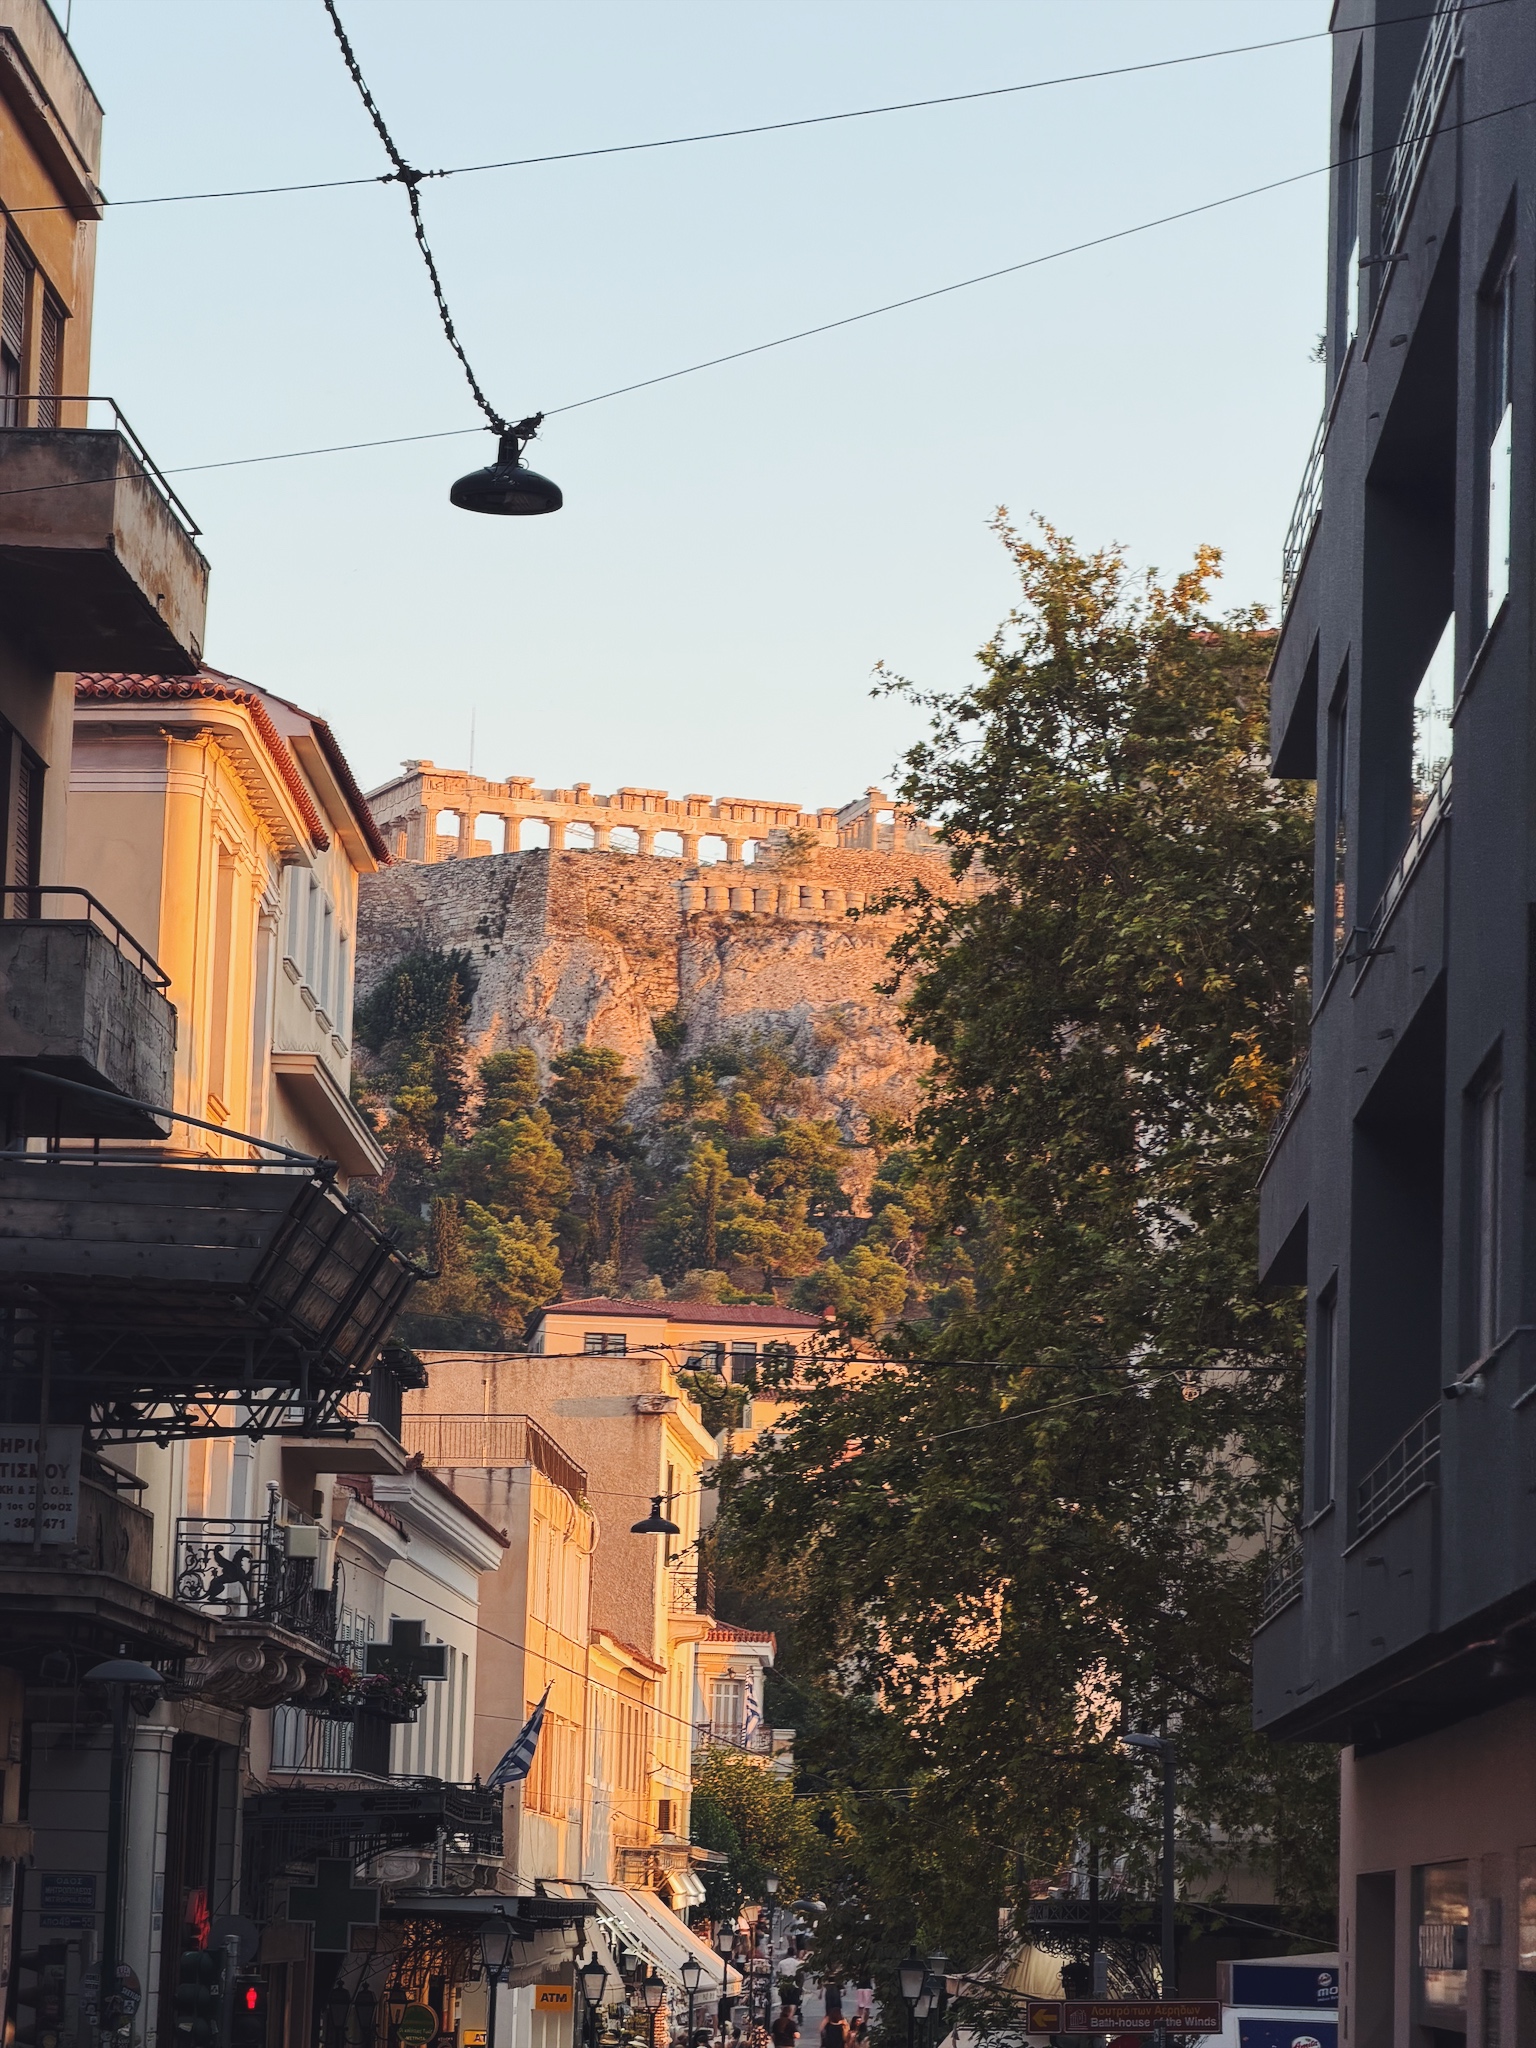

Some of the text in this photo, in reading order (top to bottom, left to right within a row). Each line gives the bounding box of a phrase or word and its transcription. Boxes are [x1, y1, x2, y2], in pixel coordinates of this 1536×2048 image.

[28, 1502, 72, 1512] ΟΟΦΟΣ
[14, 1518, 65, 1529] 324471
[56, 1877, 83, 1885] ΟΔΟΣ
[540, 1993, 568, 2003] ATM
[1091, 2006, 1130, 2017] Λουτρό
[1133, 2007, 1152, 2016] των
[1090, 2017, 1150, 2027] Bath-house
[1166, 2017, 1182, 2027] the
[1184, 2016, 1217, 2026] Winds
